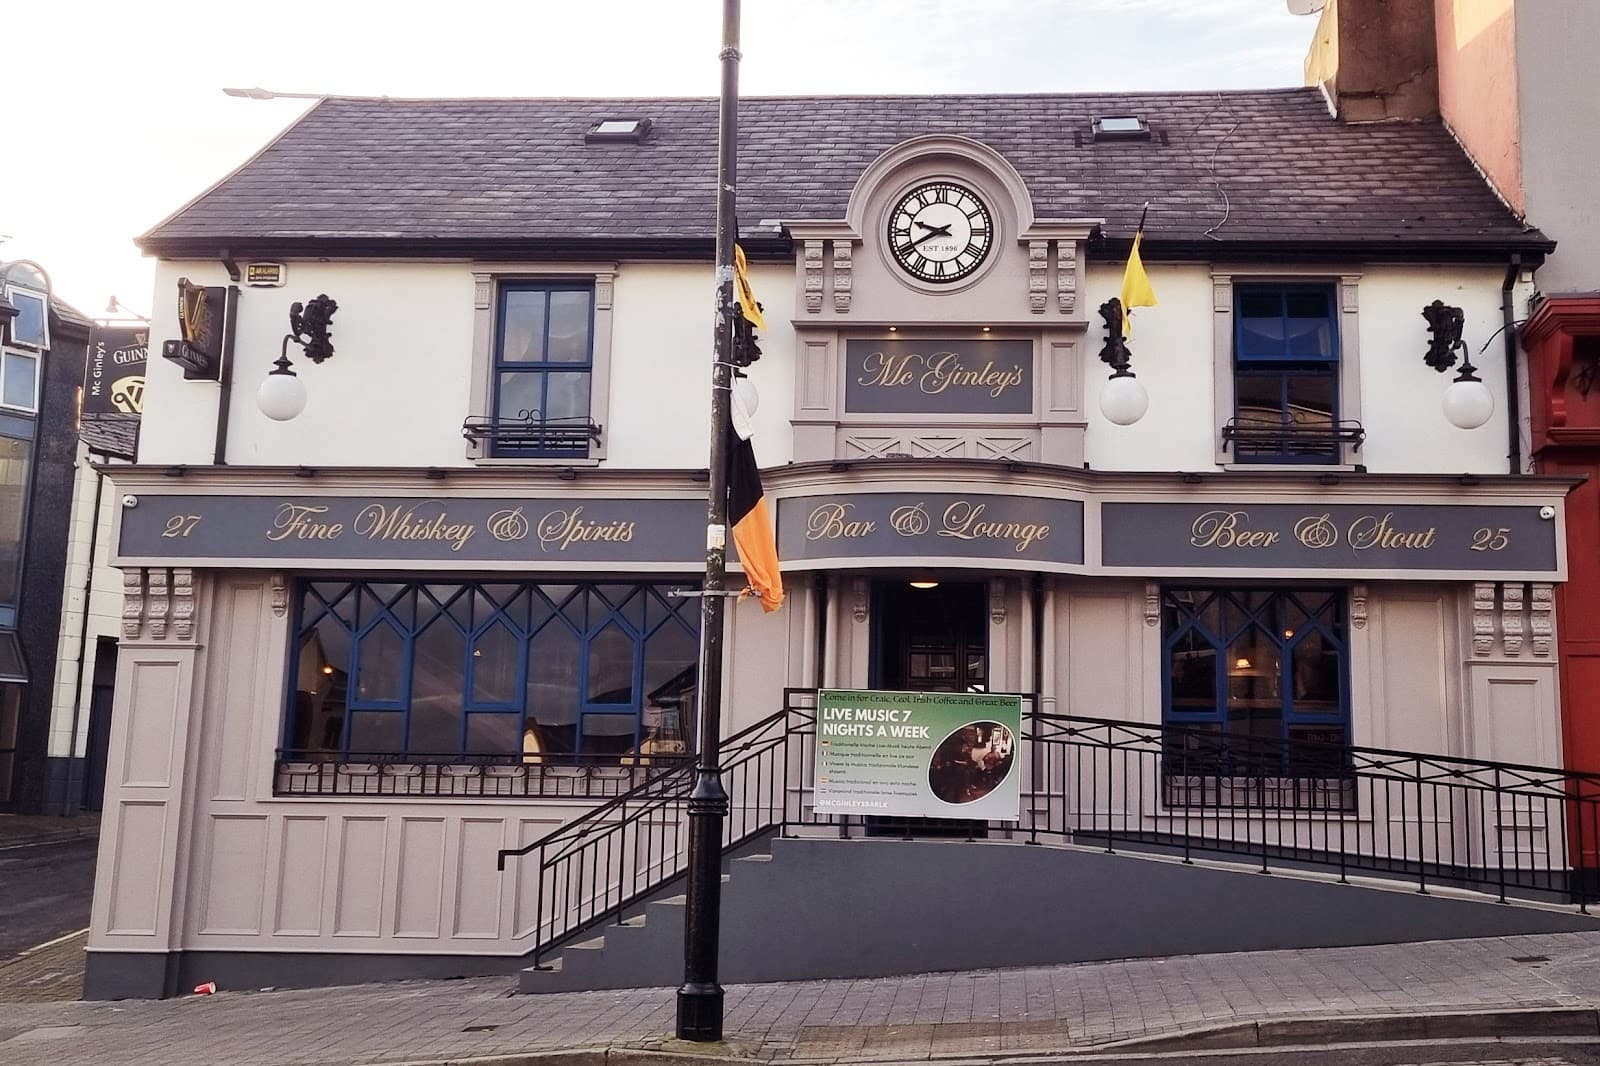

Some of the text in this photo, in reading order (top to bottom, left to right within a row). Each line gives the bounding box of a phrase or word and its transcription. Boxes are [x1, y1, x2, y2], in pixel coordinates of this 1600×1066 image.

[113, 348, 149, 364] GUINN
[92, 341, 107, 396] Mc Ginley's
[858, 352, 1023, 398] Mc Ginley's
[161, 515, 202, 538] 27
[266, 500, 636, 552] Fine Whiskey & Spirits
[806, 500, 1051, 552] Bar & Lounge
[1190, 510, 1437, 557] Beer & Stout
[1470, 528, 1511, 551] 25
[824, 693, 846, 701] Come
[847, 693, 855, 701] in
[856, 693, 868, 702] for
[913, 695, 932, 703] Irish
[933, 696, 957, 704] Coffee
[958, 697, 974, 705] and
[975, 698, 997, 706] Great
[999, 699, 1018, 707] Beer
[823, 707, 912, 722] LIVE MUSIC 7
[823, 723, 930, 738] NIGHTS A WEEK
